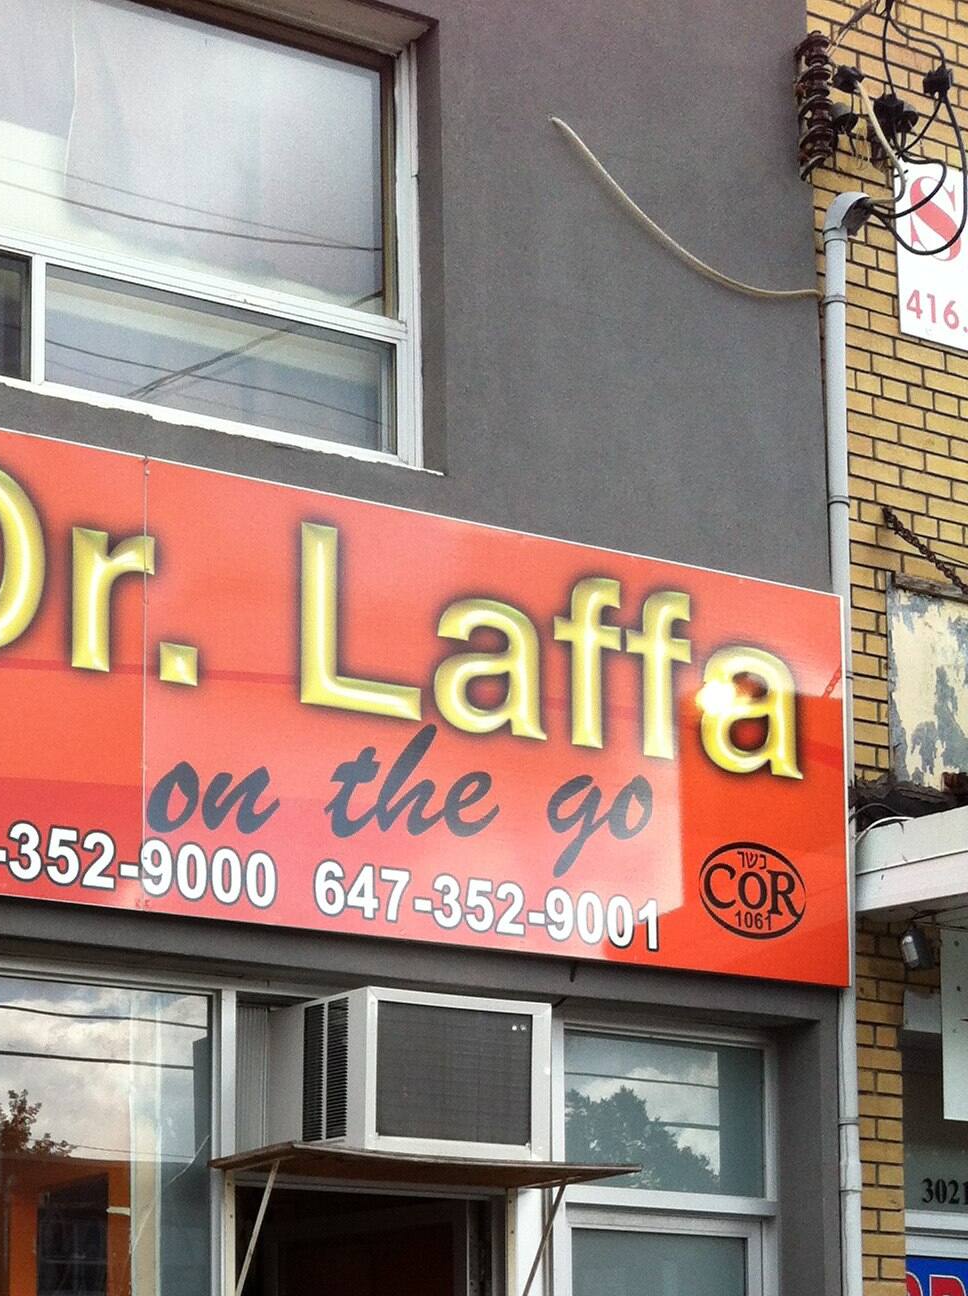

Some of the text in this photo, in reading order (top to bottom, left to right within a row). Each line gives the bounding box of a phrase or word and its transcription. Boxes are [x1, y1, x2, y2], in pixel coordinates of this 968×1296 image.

[300, 521, 804, 779] Laffa
[147, 724, 654, 877] on the go
[704, 862, 802, 918] COR
[736, 850, 767, 870] כשר
[313, 859, 661, 951] 647-352-9001
[735, 909, 772, 931] 1061
